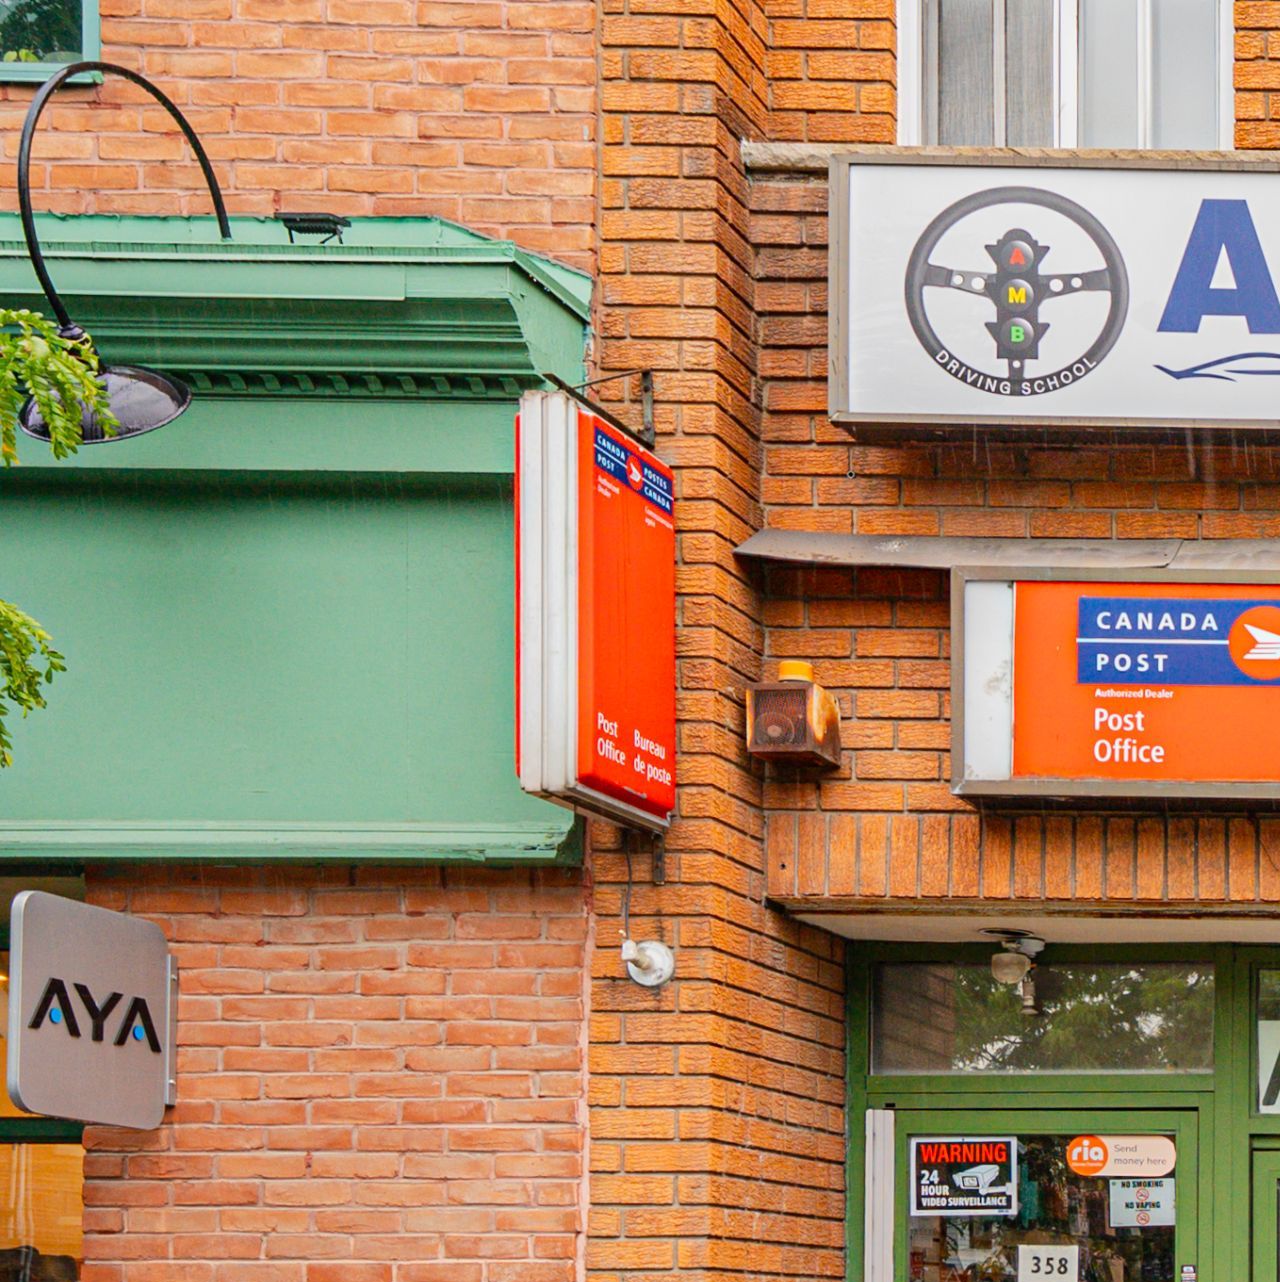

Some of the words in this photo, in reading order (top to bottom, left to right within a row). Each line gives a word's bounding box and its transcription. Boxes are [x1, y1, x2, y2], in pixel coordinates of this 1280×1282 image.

[936, 350, 1011, 394] DRIVING
[1021, 357, 1097, 395] SCHOOL
[597, 435, 626, 462] CANADA
[597, 454, 615, 472] POST
[644, 467, 667, 490] POSTES
[644, 487, 671, 511] CANADA
[1096, 611, 1219, 631] CANADA
[1096, 654, 1169, 672] POST
[1095, 688, 1143, 699] Authorized
[1145, 689, 1174, 699] Dealer
[597, 711, 618, 738] Post
[1094, 708, 1145, 732] Post
[597, 738, 626, 766] Office
[634, 729, 666, 760] Bureau
[1094, 738, 1165, 763] Office
[634, 754, 646, 774] de
[646, 763, 671, 786] poste
[920, 1143, 1007, 1163] WARNING
[1072, 1140, 1104, 1161] ria
[1114, 1144, 1137, 1153] Send
[1114, 1158, 1144, 1166] money
[1147, 1157, 1167, 1165] here
[920, 1170, 939, 1184] 24
[921, 1185, 949, 1196] HOUR
[921, 1197, 947, 1207] VIDEO
[948, 1196, 1007, 1206] SURVEILLANCE
[1136, 1201, 1161, 1209] VAPING
[1031, 1256, 1068, 1276] 358
